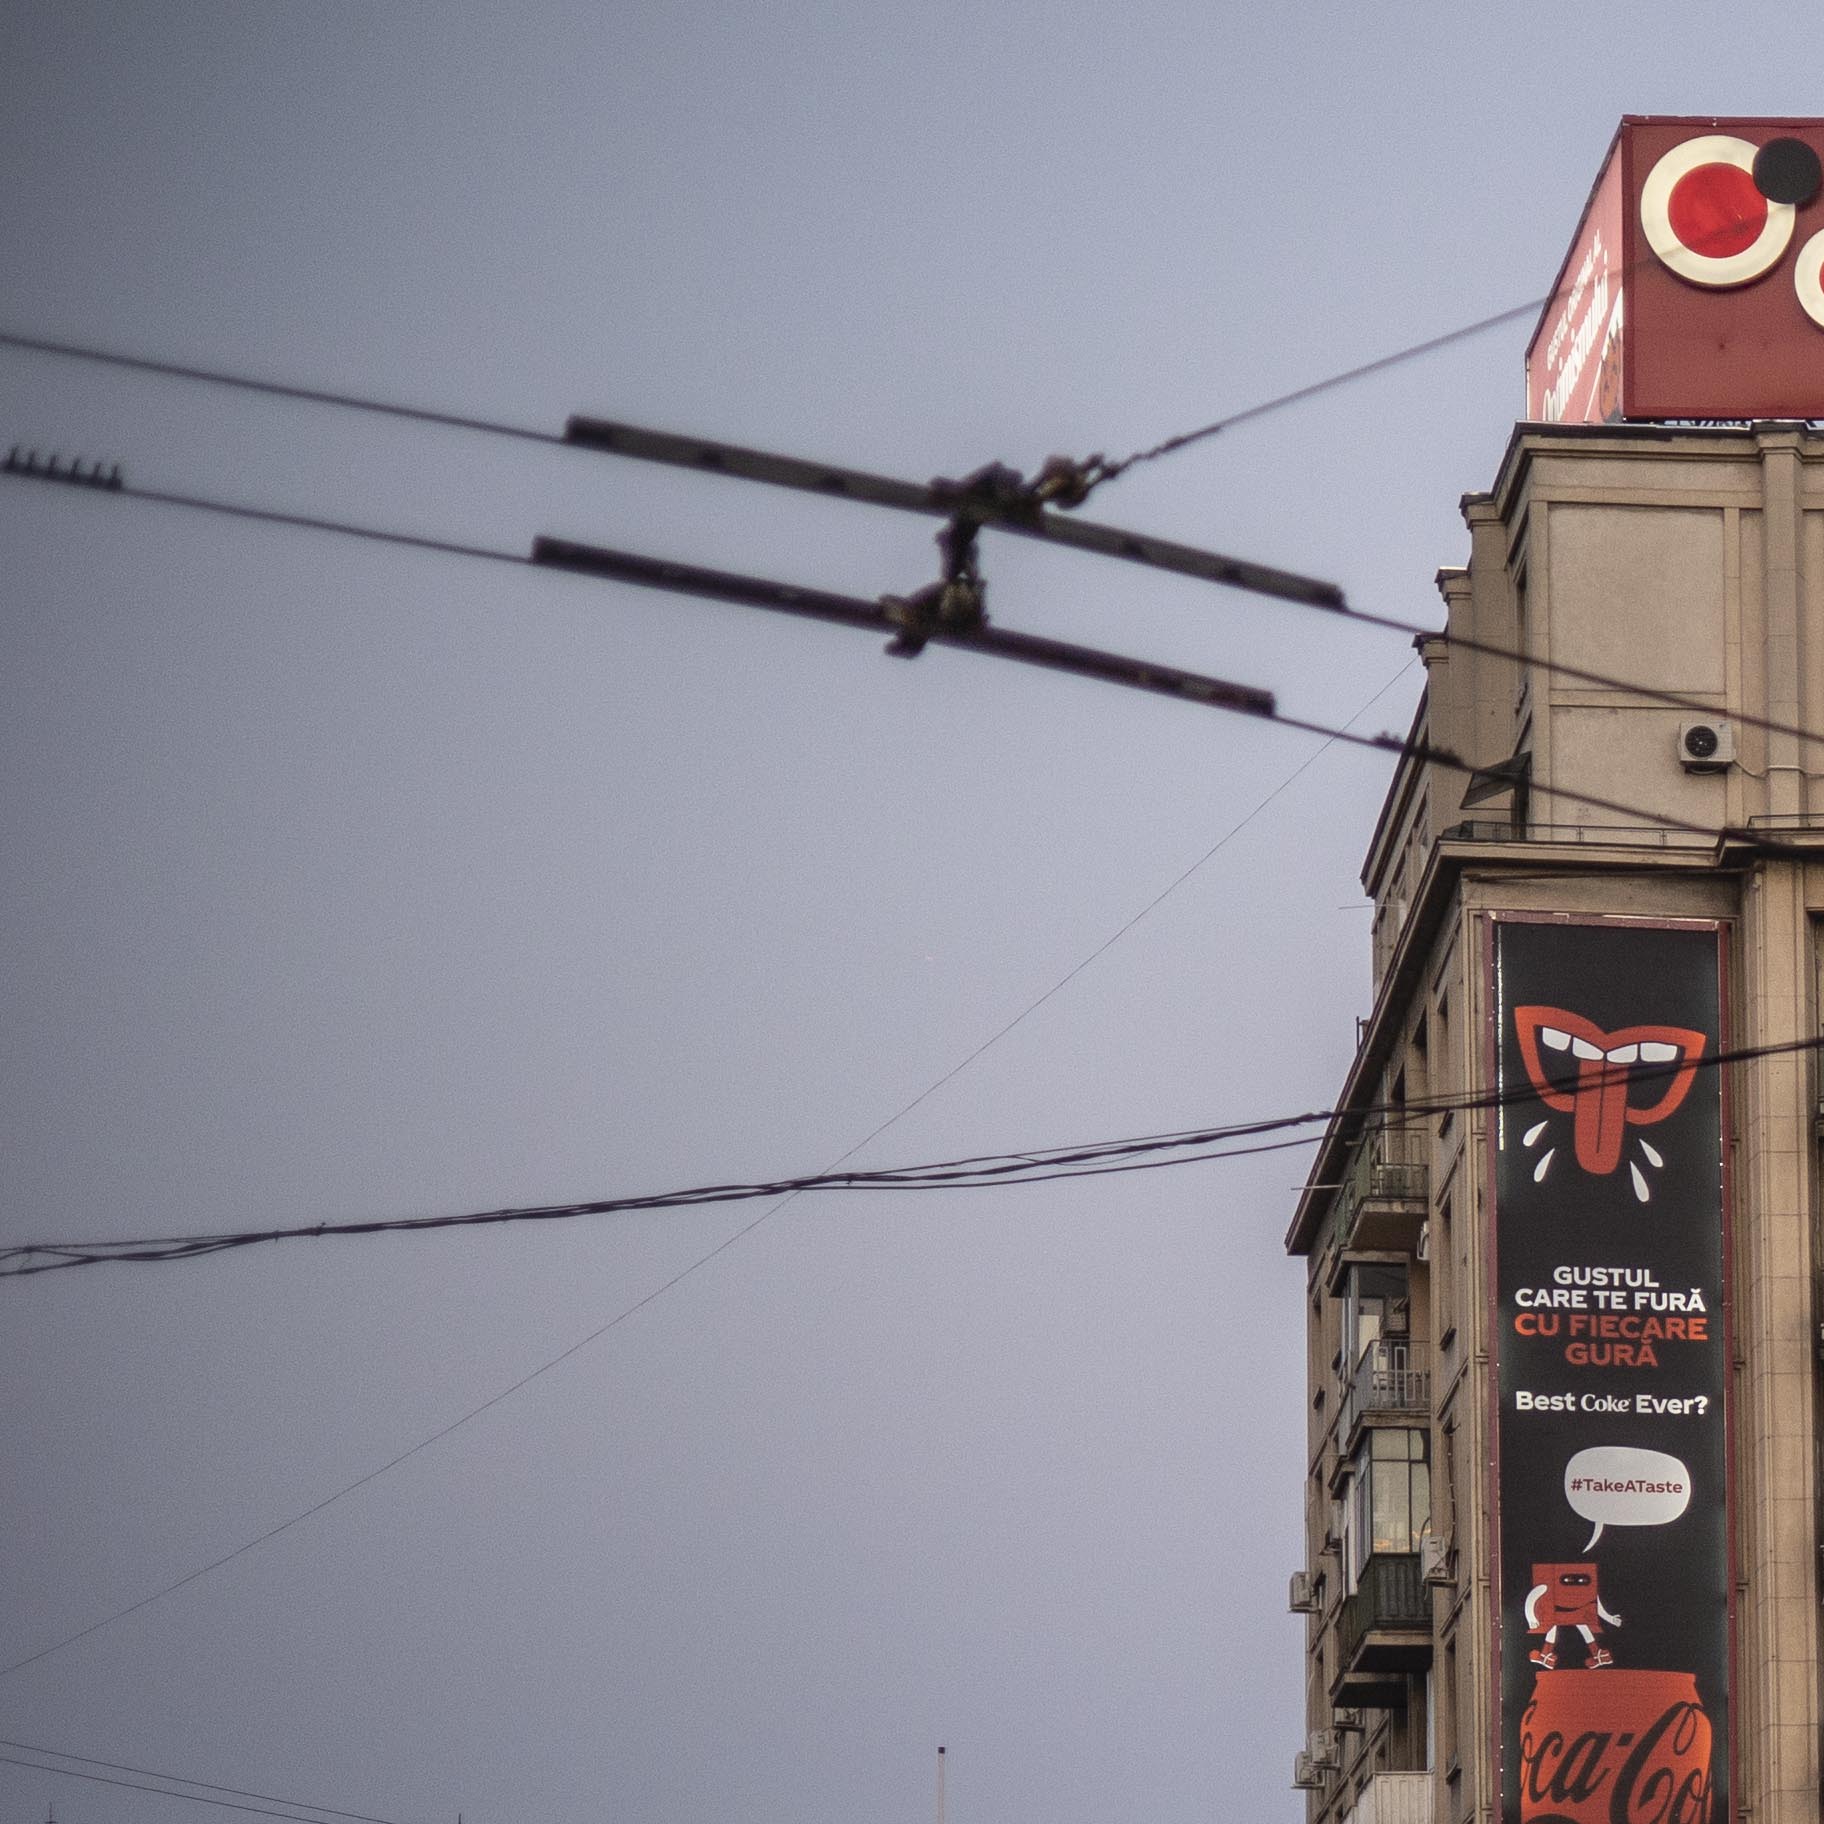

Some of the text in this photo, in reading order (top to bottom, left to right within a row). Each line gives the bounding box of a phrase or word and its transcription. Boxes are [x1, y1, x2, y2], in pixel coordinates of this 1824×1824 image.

[1553, 1266, 1659, 1288] GUSTUL
[1515, 1287, 1706, 1312] CARE TE FURĂ
[1514, 1313, 1708, 1340] CU FIECARE
[1565, 1337, 1658, 1368] GURĂ
[1515, 1391, 1709, 1416] Best Coke Ever?
[1570, 1477, 1683, 1496] #TakeATaste
